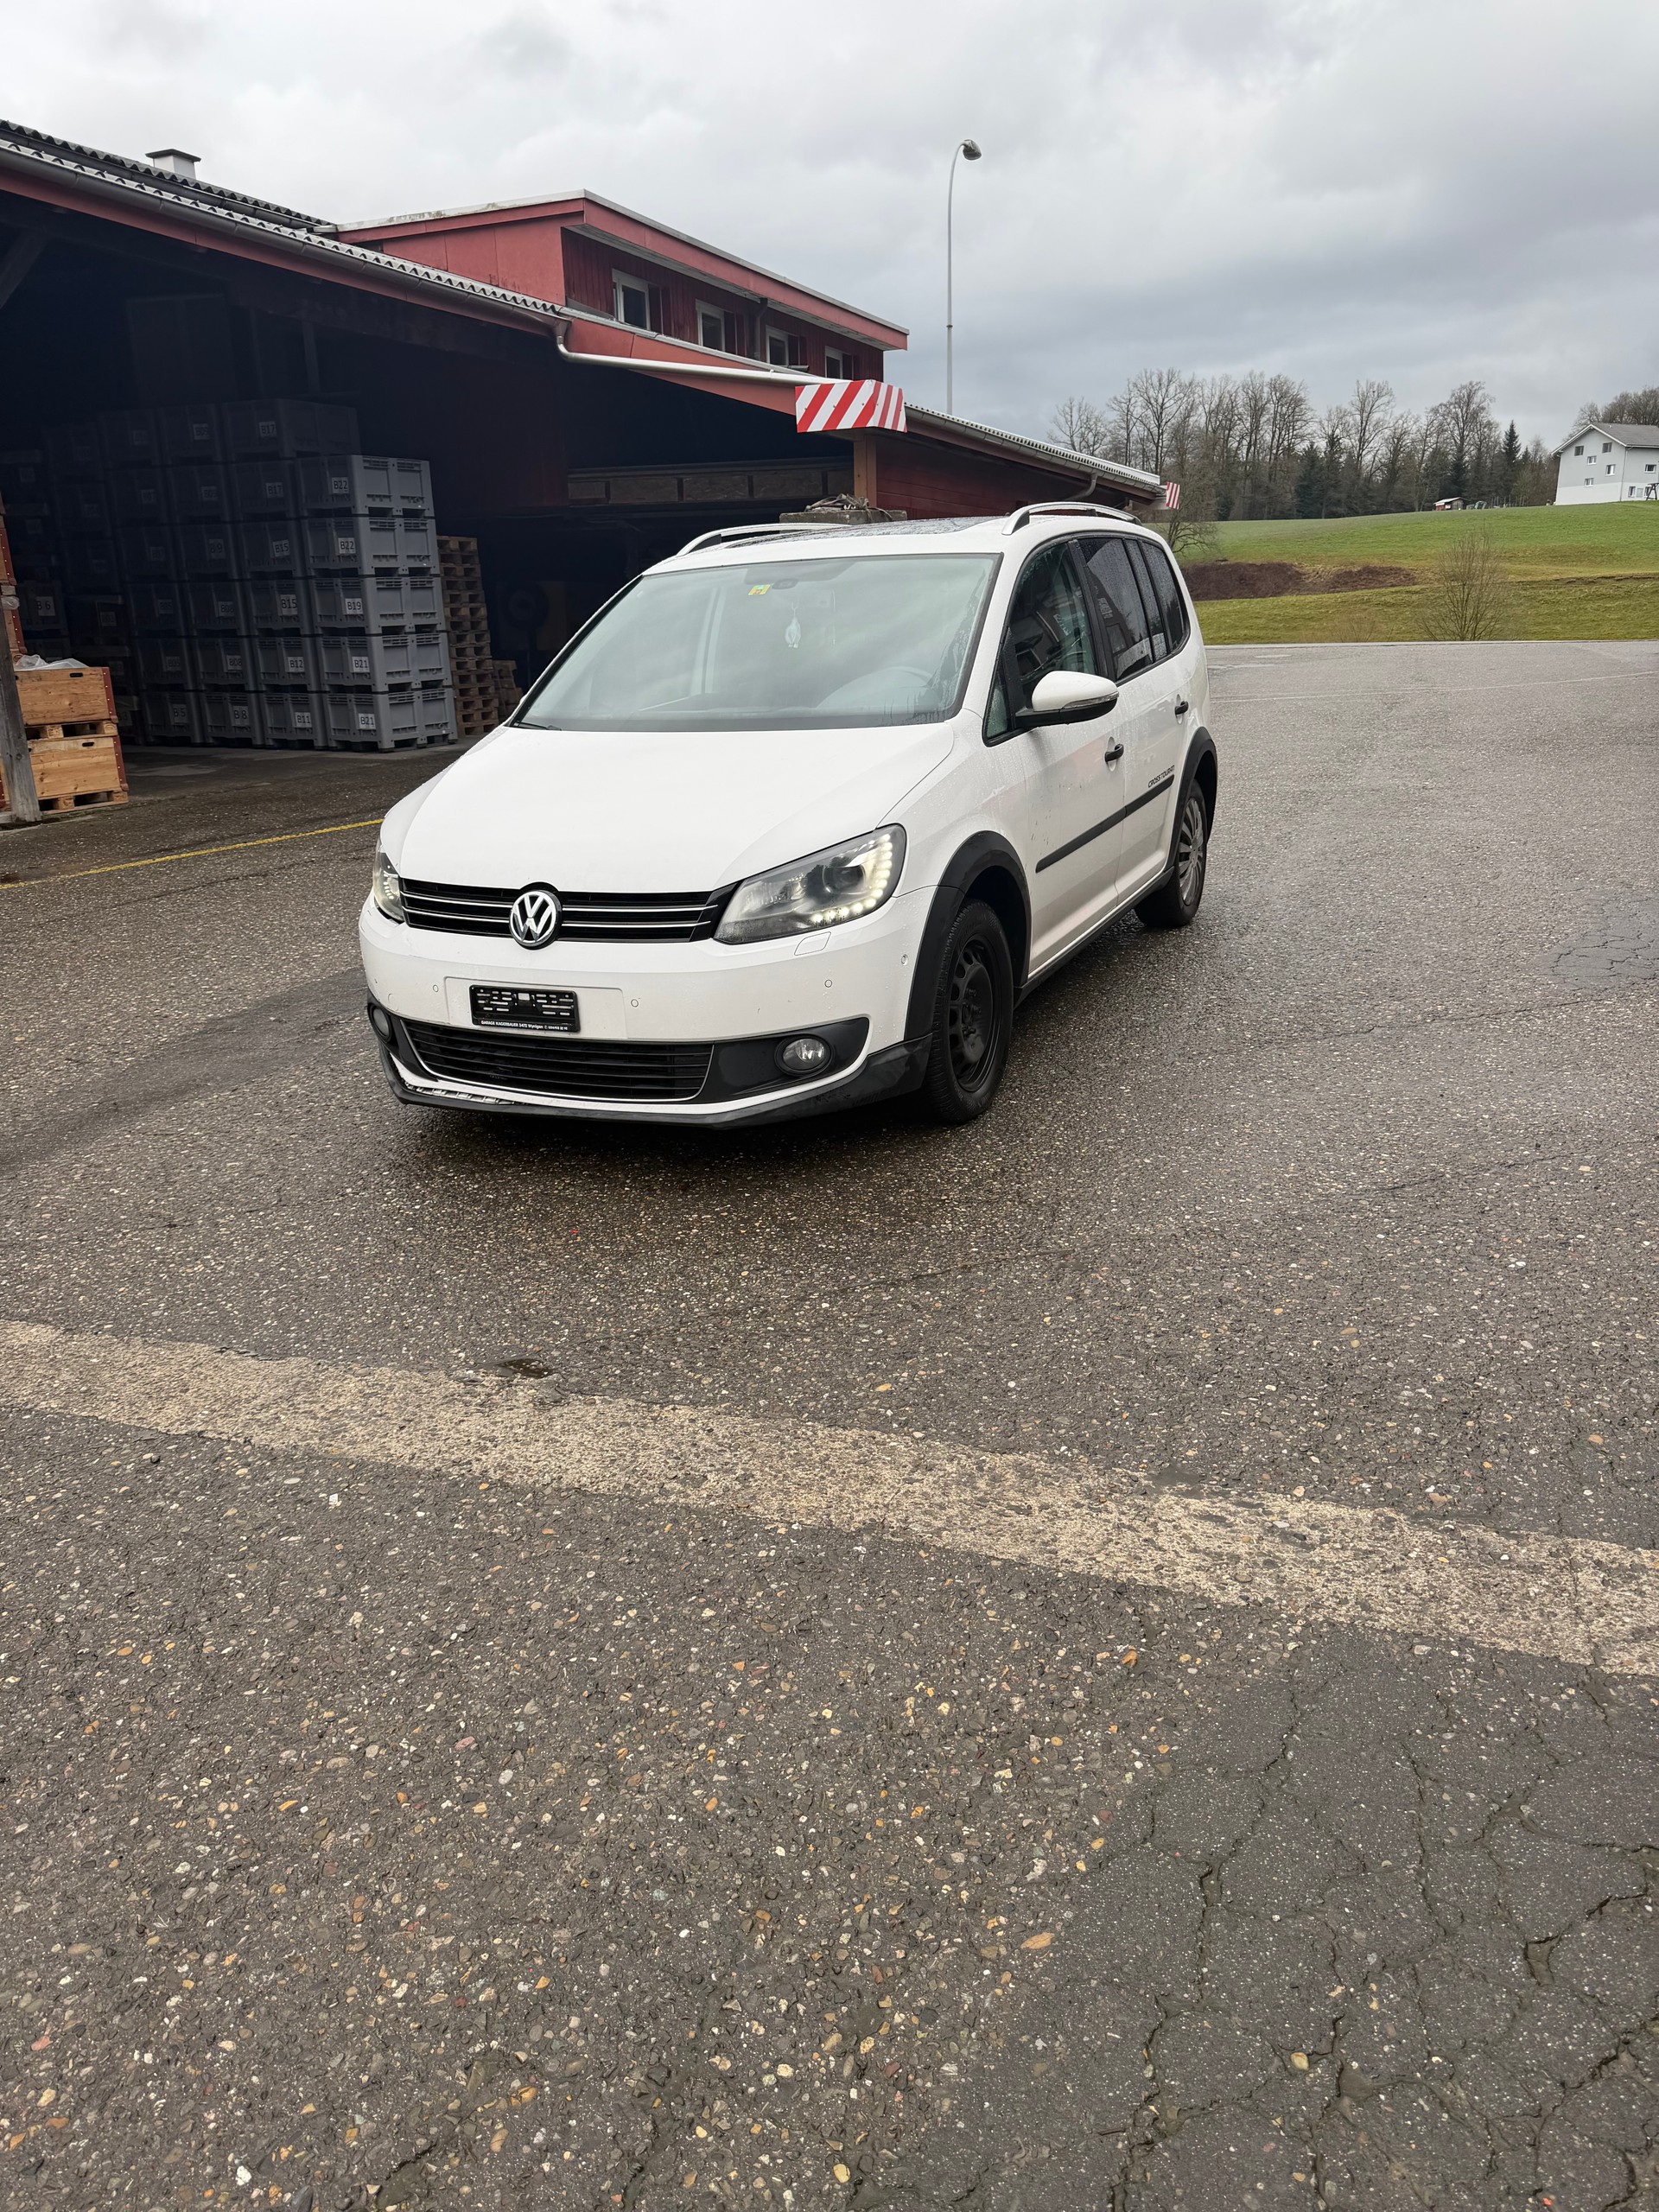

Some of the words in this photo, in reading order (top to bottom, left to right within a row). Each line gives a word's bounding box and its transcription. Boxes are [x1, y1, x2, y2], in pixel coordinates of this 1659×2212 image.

[261, 423, 276, 434] B17
[268, 485, 283, 494] B17
[334, 480, 347, 490] B22
[274, 542, 290, 553] B15
[340, 541, 354, 550] B22
[281, 598, 297, 609] B15
[347, 601, 362, 610] B19
[289, 659, 303, 669] B12
[354, 659, 368, 669] B21
[296, 715, 311, 724] B11
[360, 716, 375, 726] B21
